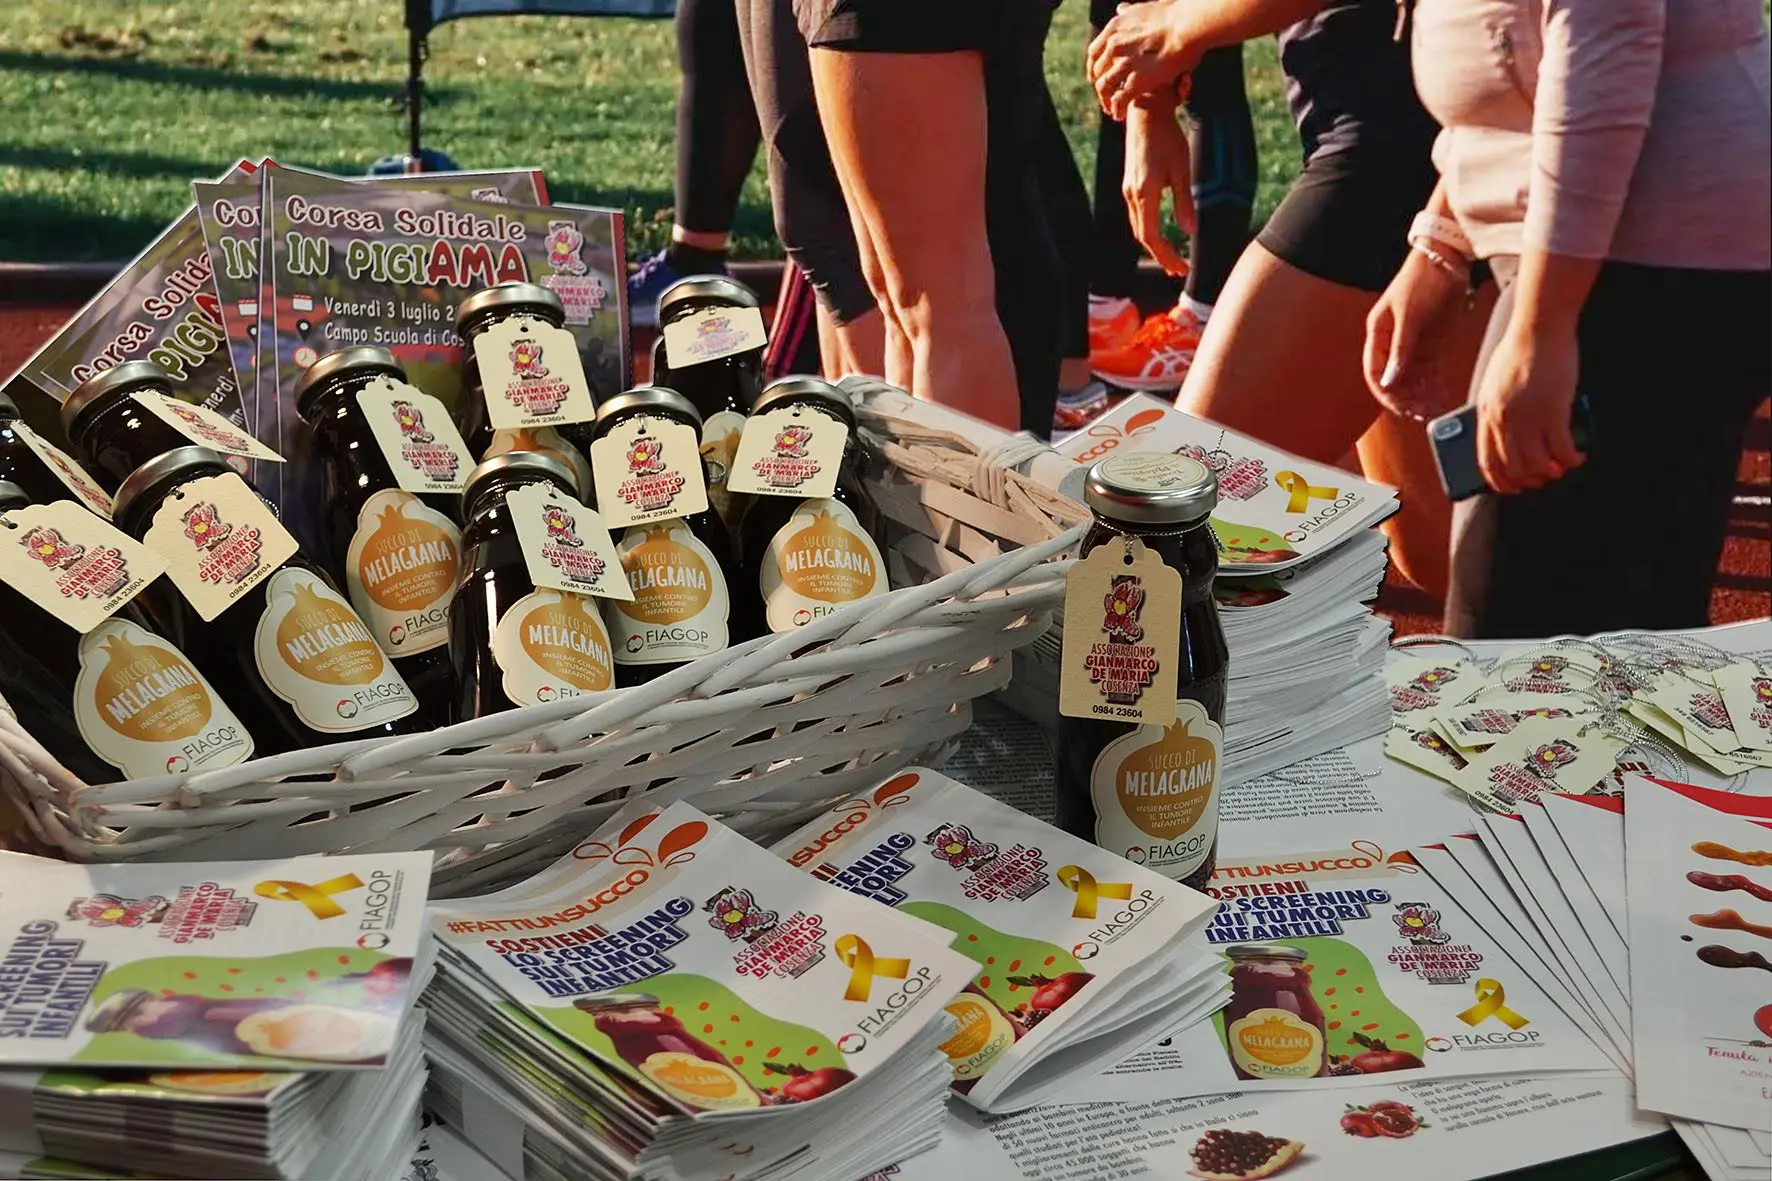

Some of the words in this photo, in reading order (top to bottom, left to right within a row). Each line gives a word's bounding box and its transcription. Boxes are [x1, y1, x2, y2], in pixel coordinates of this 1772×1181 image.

[286, 195, 384, 231] Corsa
[394, 208, 526, 242] Solidale
[286, 232, 330, 276] IN
[346, 238, 528, 288] PIGIAMA
[324, 296, 381, 317] Venerdì
[387, 302, 395, 318] 3
[401, 303, 440, 325] luglio
[324, 322, 368, 344] Campo
[374, 327, 421, 344] Scuola
[424, 329, 436, 346] di
[442, 330, 466, 347] Cos
[71, 321, 154, 383] Corsa
[505, 384, 567, 397] GIANMARCO
[513, 396, 525, 404] DE
[529, 392, 563, 403] MARIA
[754, 462, 818, 471] GIANMARCO
[776, 470, 811, 478] MARIA
[1218, 460, 1261, 491] MARCO
[1228, 468, 1264, 492] MARIA
[618, 477, 682, 495] GIANMARCO
[643, 485, 678, 499] MARIA
[631, 513, 651, 521] 0984
[653, 508, 678, 517] 23604
[1298, 492, 1357, 533] FIAGOP
[199, 529, 258, 579] GIANMARCO
[376, 533, 406, 555] SUCCO
[803, 536, 834, 548] SUCCO
[210, 570, 224, 582] DE
[225, 541, 259, 569] MARIA
[364, 540, 451, 587] MELAGRANA
[542, 549, 602, 565] GIANMARCO
[567, 560, 600, 571] MARIA
[785, 548, 871, 577] MELAGRANA
[61, 550, 117, 596] GIANMARCO
[74, 585, 89, 598] DE
[88, 560, 122, 588] MARIA
[229, 582, 249, 599] 0984
[248, 563, 272, 583] 23604
[625, 566, 707, 592] ELAGRANA
[103, 596, 123, 612] 0984
[122, 577, 145, 597] 23604
[631, 595, 662, 606] INSIEME
[651, 600, 686, 608] TUMORE
[645, 608, 684, 616] INFANTILE
[286, 621, 373, 664] MELAGRANA
[529, 624, 610, 672] MELAGRANA
[646, 628, 708, 643] FIAGOP
[1086, 655, 1155, 671] GIANMARCO
[1092, 668, 1106, 679] DE
[1110, 669, 1148, 682] MARIA
[105, 664, 199, 724] MELAGRANA
[354, 683, 406, 706] FIAGOP
[1101, 680, 1139, 693] COSENZA
[1092, 705, 1113, 715] 0984
[1117, 707, 1142, 718] 23604
[182, 726, 238, 760] FIAGOP
[1150, 752, 1181, 770] SUCCO
[1185, 749, 1196, 767] DI
[1125, 759, 1212, 797] MELAGRANA
[1506, 780, 1540, 802] MARIA
[1137, 804, 1172, 813] INSIEME
[1173, 796, 1203, 810] CONTRO
[1159, 809, 1193, 820] TUMORE
[1152, 817, 1191, 829] INFANTILE
[837, 834, 912, 887] ENING
[1150, 833, 1206, 861] FIAGOP
[964, 847, 1040, 900] GIANMARCO
[983, 887, 999, 902] DE
[1000, 860, 1043, 890] MARIA
[1000, 872, 1044, 901] COSENZA
[173, 884, 215, 944] GIANMARCO
[201, 889, 230, 928] MARIA
[360, 870, 391, 931] FIAGOP
[446, 869, 650, 934] #FATTIUNSUCCO
[1236, 889, 1388, 913] SCREENING
[1088, 889, 1157, 942] FIAGOP
[1252, 904, 1368, 927] TUMORI
[194, 927, 213, 939] DE
[486, 924, 607, 954] SOSTIENI
[502, 952, 541, 968] LO
[544, 898, 691, 964] SCREENING
[1205, 920, 1340, 943] INFANTILI
[519, 963, 570, 981] SUI
[575, 926, 686, 973] TUMORI
[736, 916, 819, 975] GIANMARCO
[752, 964, 773, 978] DE
[773, 929, 823, 964] MARIA
[1388, 953, 1478, 963] GIANMARCO
[0, 920, 56, 1010] CREENING
[12, 940, 82, 1004] TUMORI
[773, 944, 819, 977] COSENZA
[1400, 962, 1419, 970] DE
[1424, 961, 1475, 970] MARIA
[1417, 970, 1466, 978] COSENZA
[536, 953, 674, 996] INFANTILI
[29, 962, 104, 1039] INFANTILI
[857, 966, 931, 1034] FIAGOP
[1243, 1034, 1310, 1049] MELAGRANA
[1453, 1031, 1540, 1046] FIAGOP
[1706, 1046, 1759, 1063] Tenuta
[1262, 1065, 1309, 1073] FIAGOP
[1044, 1122, 1055, 1130] 10
